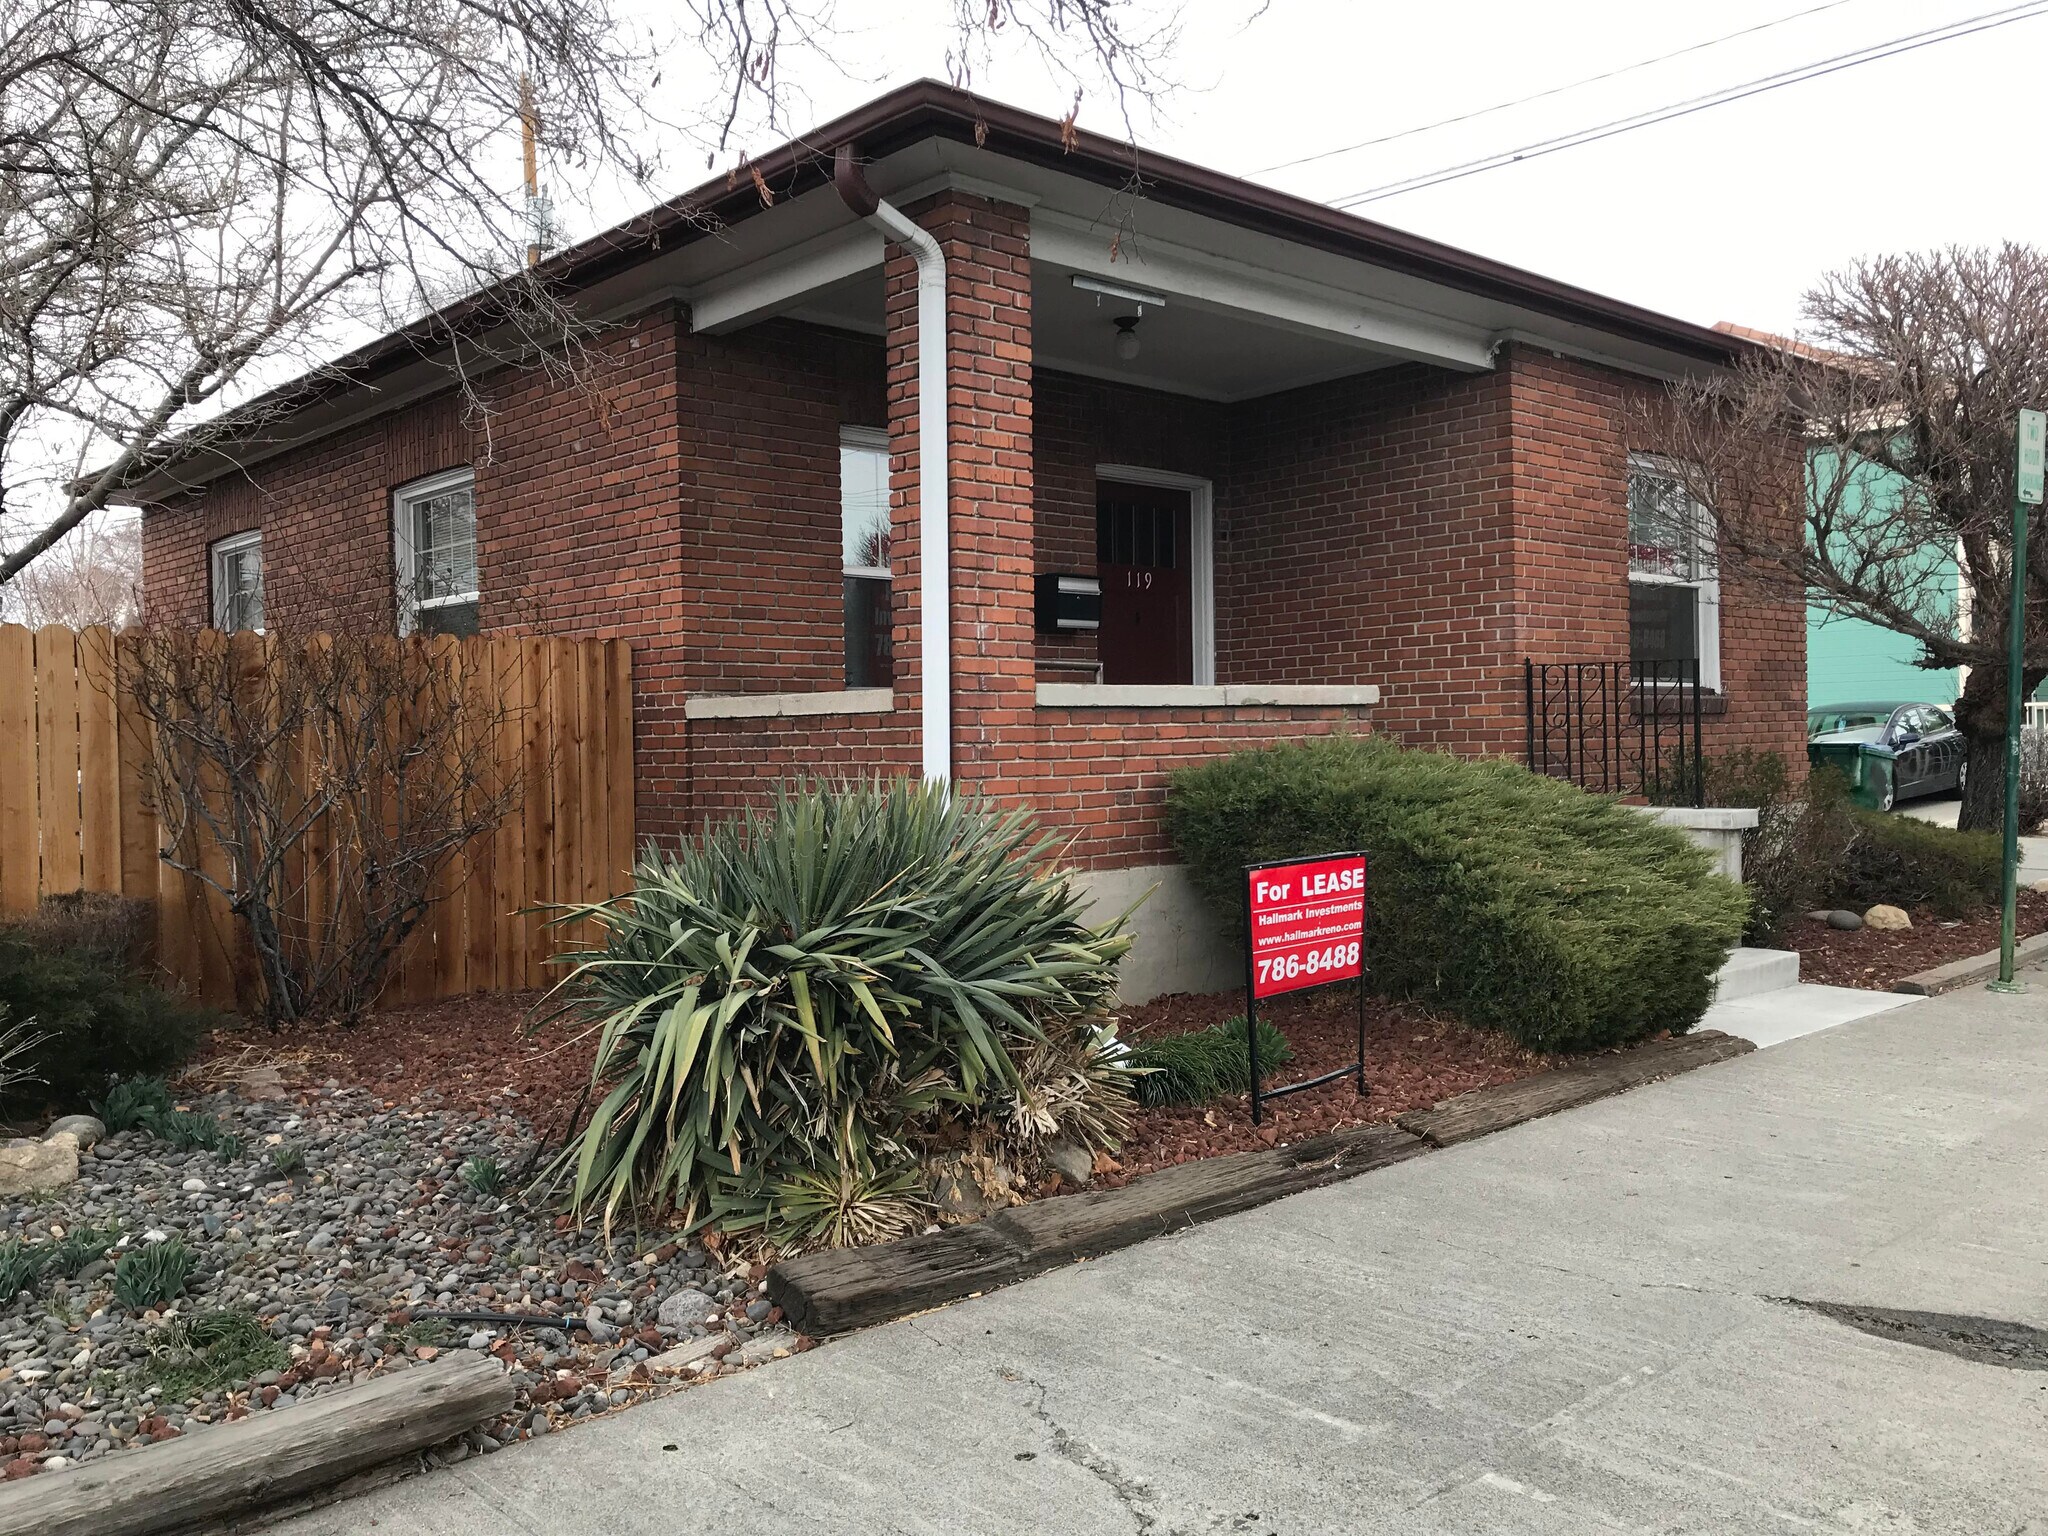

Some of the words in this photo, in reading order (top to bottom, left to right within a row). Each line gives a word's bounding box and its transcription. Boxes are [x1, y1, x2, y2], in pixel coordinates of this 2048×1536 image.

[1127, 570, 1152, 589] 119
[1256, 881, 1290, 903] For
[1302, 868, 1365, 897] LEASE
[1258, 910, 1303, 926] Hallmark
[1305, 900, 1363, 919] Investments
[1258, 921, 1361, 946] www.hallmarkreno.com
[1257, 942, 1360, 984] 786-8488
